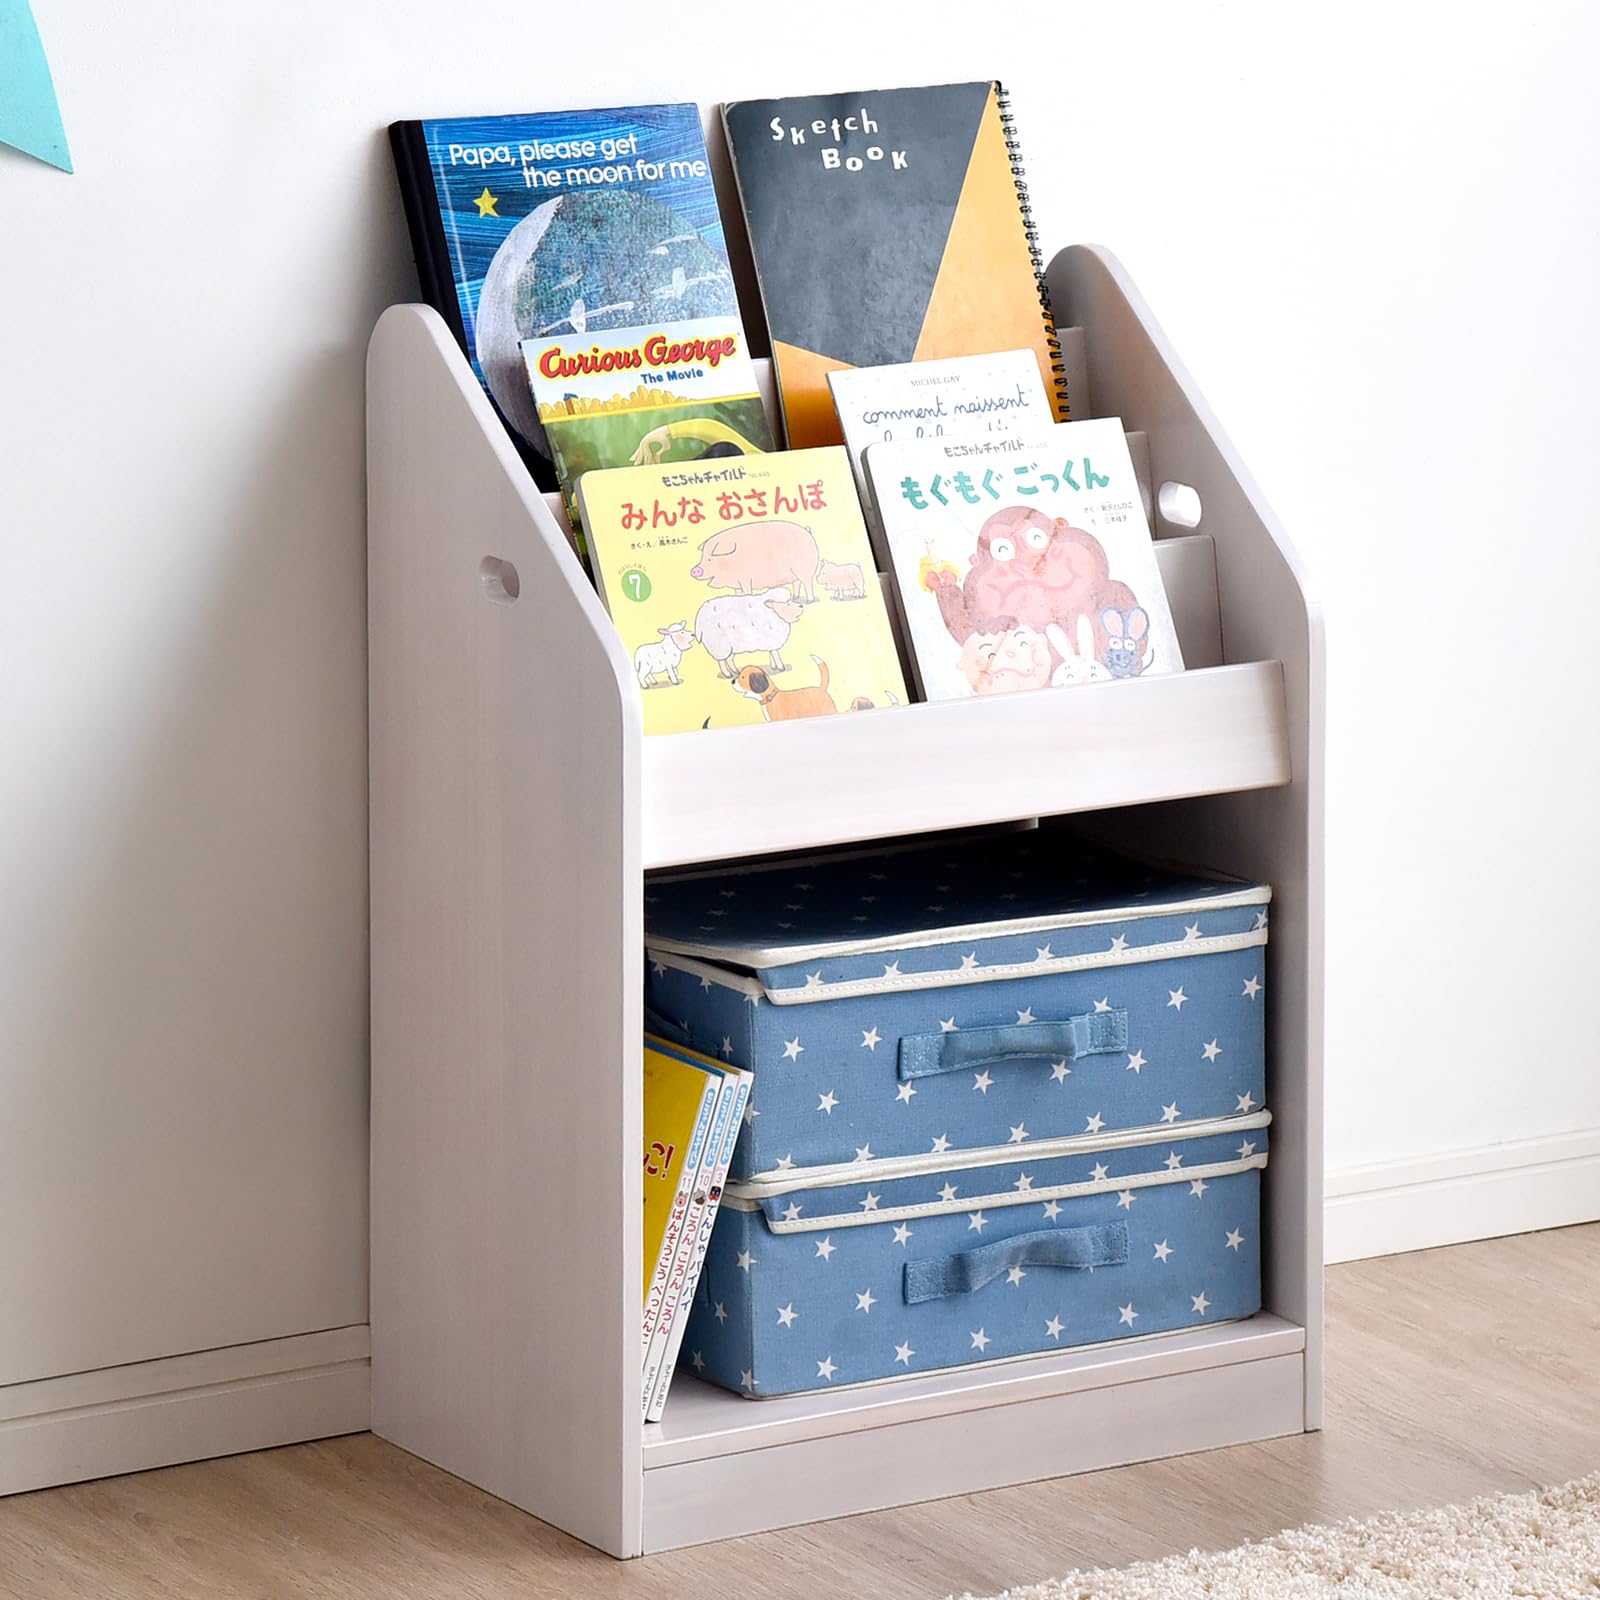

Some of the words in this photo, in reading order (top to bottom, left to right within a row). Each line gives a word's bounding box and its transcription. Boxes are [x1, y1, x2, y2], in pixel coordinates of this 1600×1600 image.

[449, 144, 516, 169] Papa,
[519, 138, 595, 167] please
[600, 132, 638, 161] get
[522, 166, 561, 189] the
[567, 162, 632, 185] moon
[636, 158, 665, 180] for
[670, 160, 708, 178] me
[539, 346, 642, 379] Curious
[644, 335, 737, 368] George
[640, 373, 664, 385] The
[667, 368, 704, 382] Movie
[910, 377, 943, 387] MICHEL
[944, 375, 961, 384] GAY
[862, 396, 947, 424] comment
[954, 383, 1029, 415] naissent
[900, 468, 1004, 509] もぐもぐ
[1013, 457, 1110, 496] ごっくん
[620, 497, 706, 531] みんな
[716, 479, 828, 521] おさんぽ
[628, 573, 641, 599] 7
[682, 1176, 692, 1188] 11
[699, 1174, 710, 1187] 10
[715, 1172, 723, 1184] 3
[681, 1206, 700, 1246] ころん
[697, 1204, 717, 1253] でんしゃ
[669, 1251, 689, 1290] ころん
[657, 1296, 675, 1335] ころん
